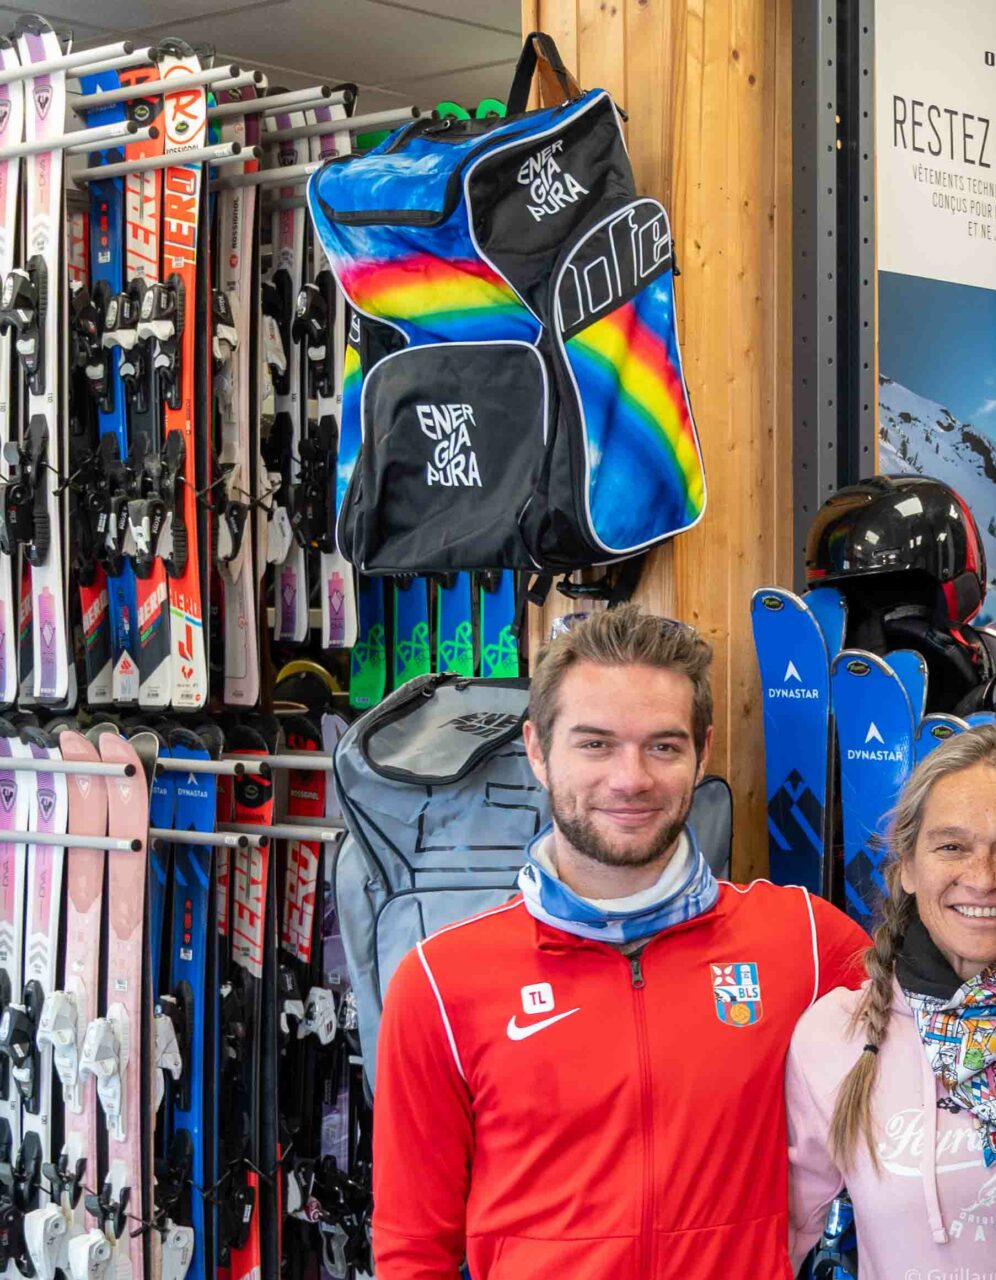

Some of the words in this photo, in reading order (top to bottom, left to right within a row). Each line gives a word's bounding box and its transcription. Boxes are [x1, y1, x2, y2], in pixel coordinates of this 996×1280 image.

[892, 95, 991, 169] RESTEZ
[517, 139, 564, 185] ENER
[912, 162, 966, 192] VÊTEMENTS
[530, 156, 562, 204] GIA
[526, 172, 590, 223] PURA
[932, 192, 968, 217] CONÇUS
[970, 198, 994, 219] POUR
[967, 221, 980, 238] ET
[981, 224, 993, 241] NE
[415, 403, 477, 441] ENER
[434, 422, 472, 469] GIA
[426, 451, 483, 488] PURA
[769, 688, 819, 699] DYNASTAR
[847, 749, 904, 762] DYNASTAR
[177, 788, 208, 799] DYNASTAR
[528, 991, 547, 1006] TL
[738, 987, 759, 999] BLS
